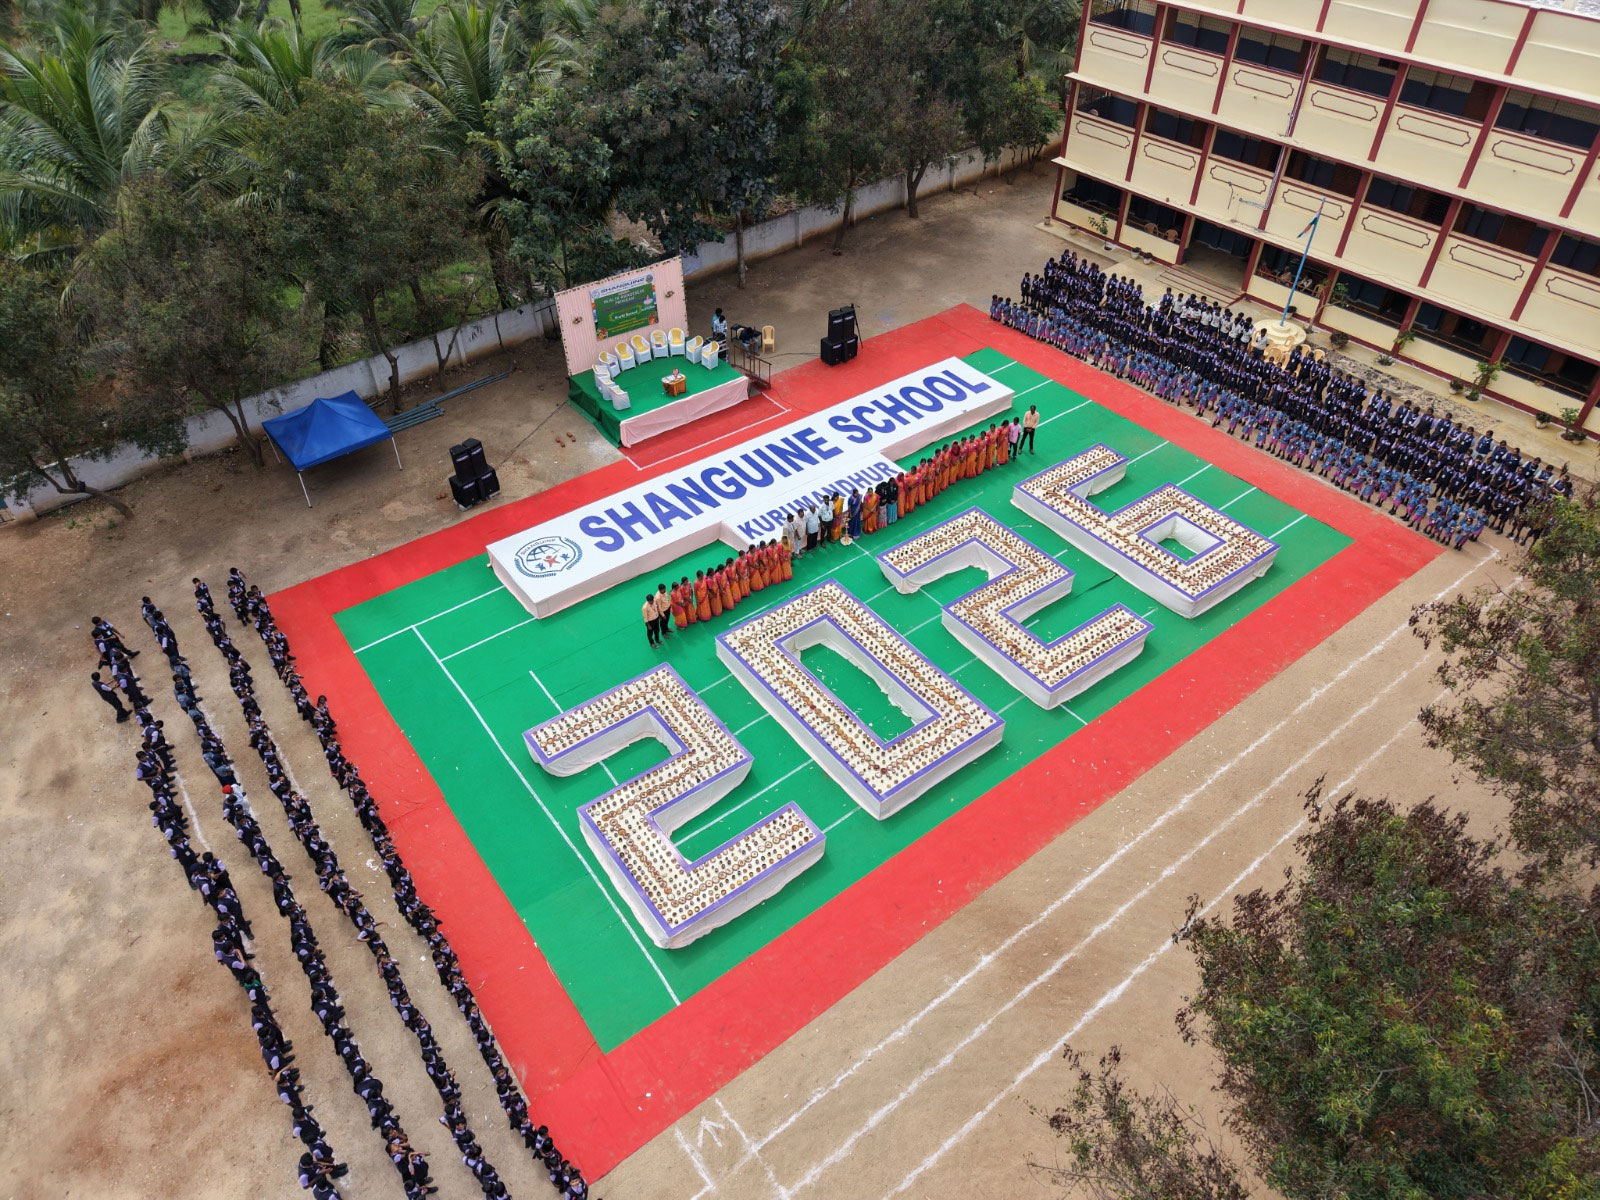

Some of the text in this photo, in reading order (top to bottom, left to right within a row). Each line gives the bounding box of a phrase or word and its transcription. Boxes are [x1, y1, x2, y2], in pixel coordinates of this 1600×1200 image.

[579, 370, 991, 552] SHANGUINE SCHOOL
[522, 444, 1280, 950] 2026
